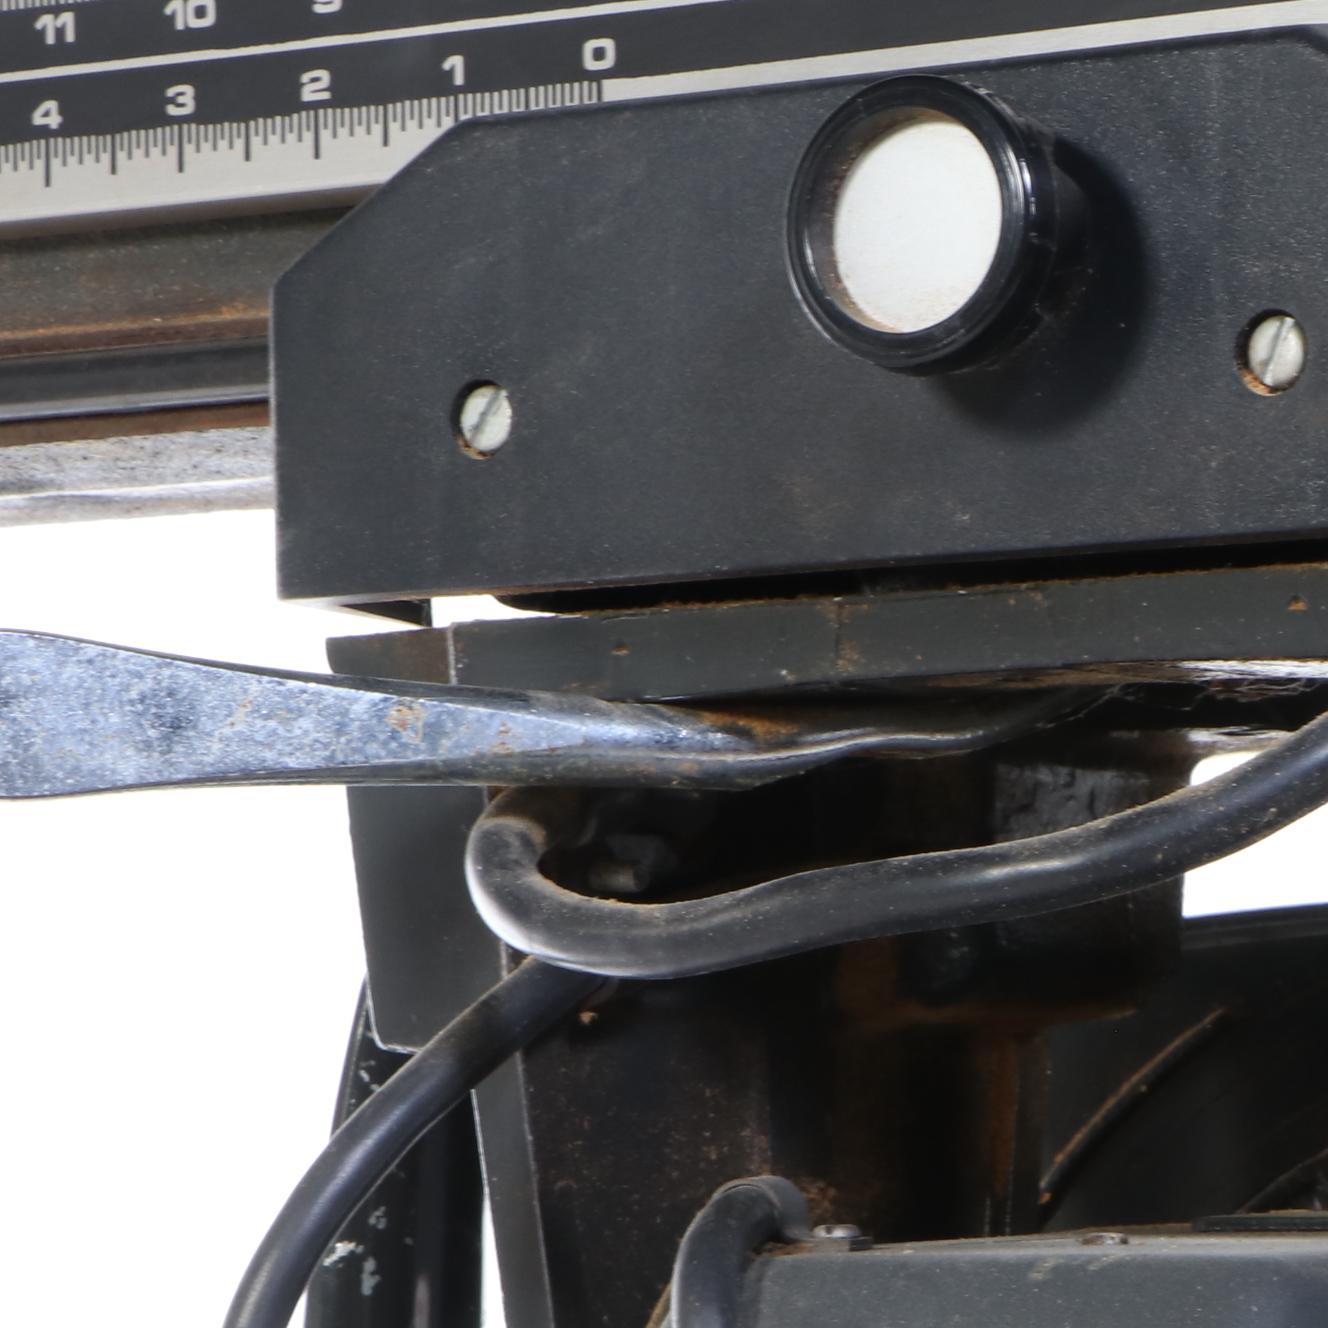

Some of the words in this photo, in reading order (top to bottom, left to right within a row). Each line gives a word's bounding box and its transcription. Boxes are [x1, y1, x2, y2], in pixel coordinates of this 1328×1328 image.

[34, 11, 76, 45] 11
[163, 0, 217, 30] 10
[31, 99, 63, 130] 4
[165, 84, 196, 116] 3
[300, 69, 331, 102] 2
[441, 54, 465, 86] 1
[582, 37, 616, 71] 0
